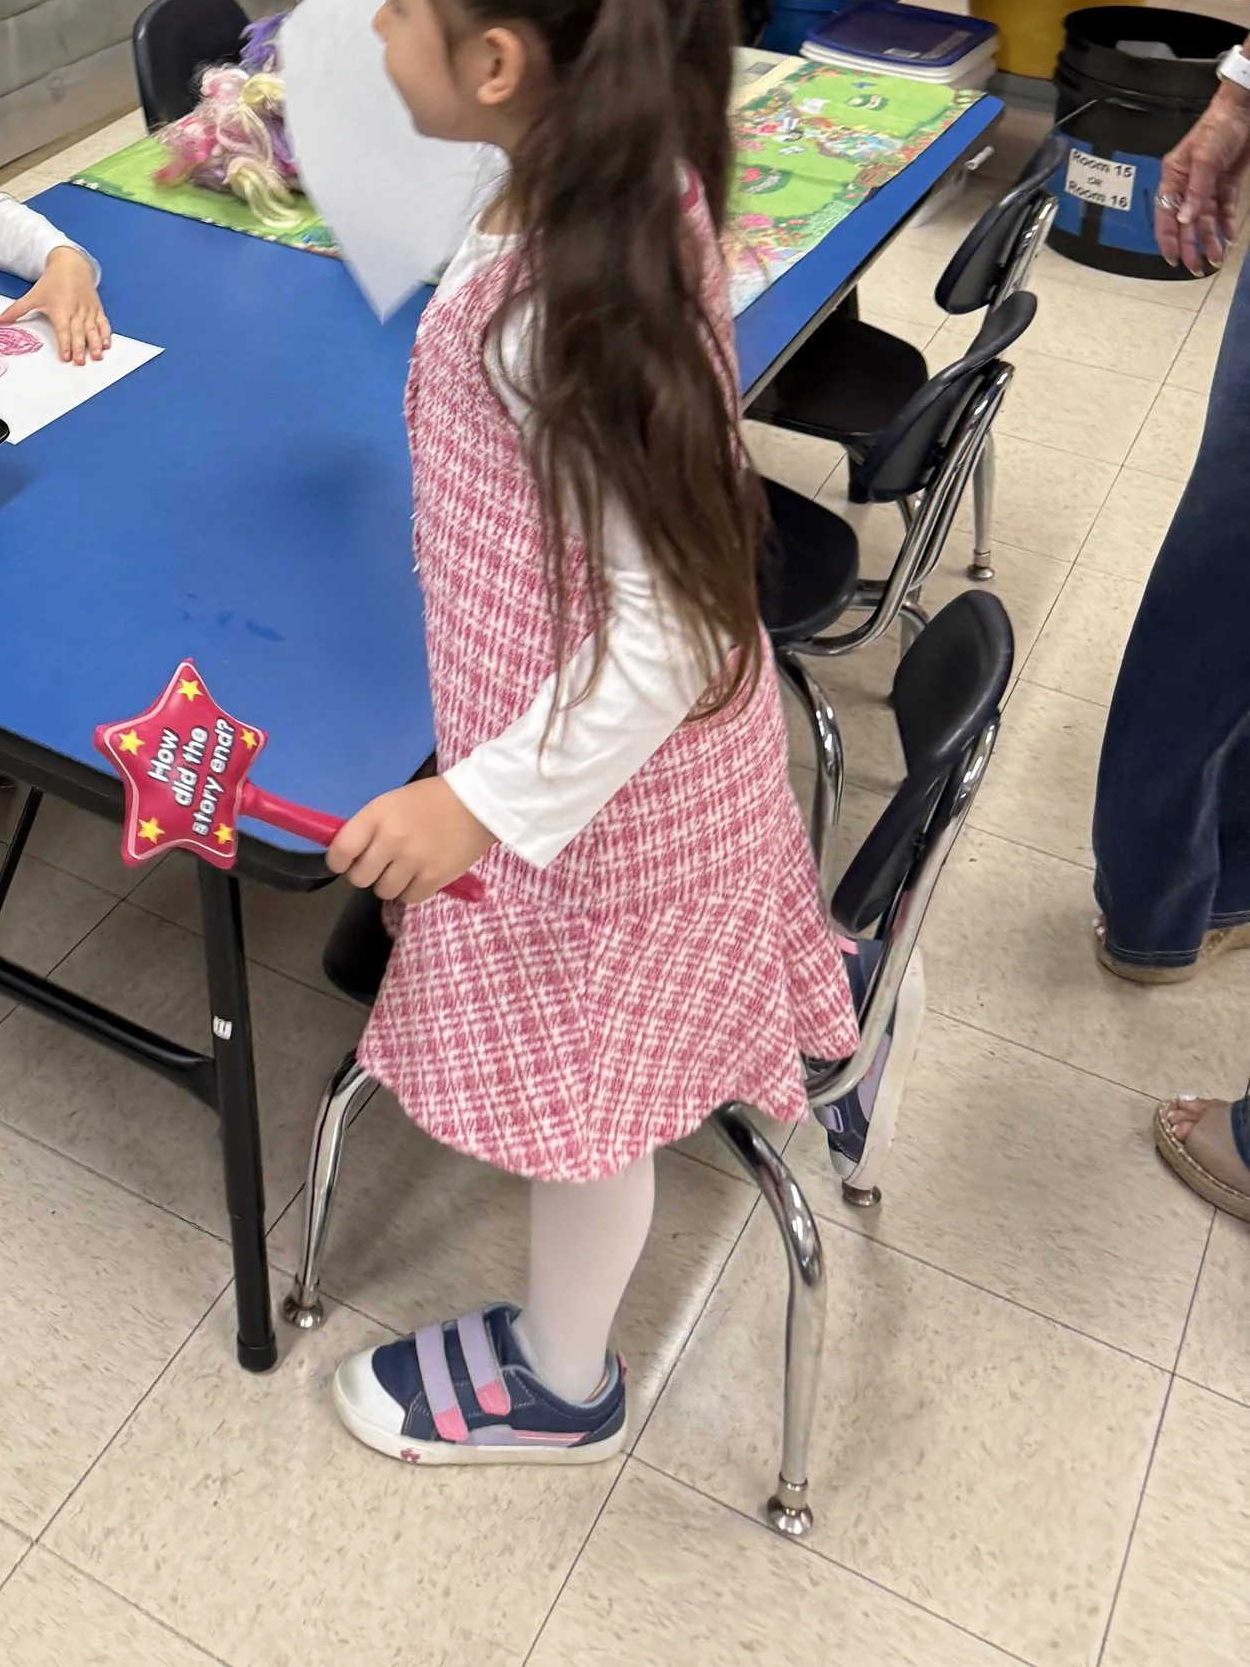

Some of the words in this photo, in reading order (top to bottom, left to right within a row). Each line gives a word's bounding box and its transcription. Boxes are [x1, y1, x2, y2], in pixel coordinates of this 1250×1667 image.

[1072, 150, 1110, 173] Room
[1114, 164, 1133, 178] 15
[1068, 180, 1106, 202] Room
[1110, 195, 1128, 208] 16
[147, 726, 180, 782] How
[181, 724, 209, 764] the
[208, 716, 236, 774] end?
[171, 766, 199, 807] did
[191, 775, 226, 836] story
